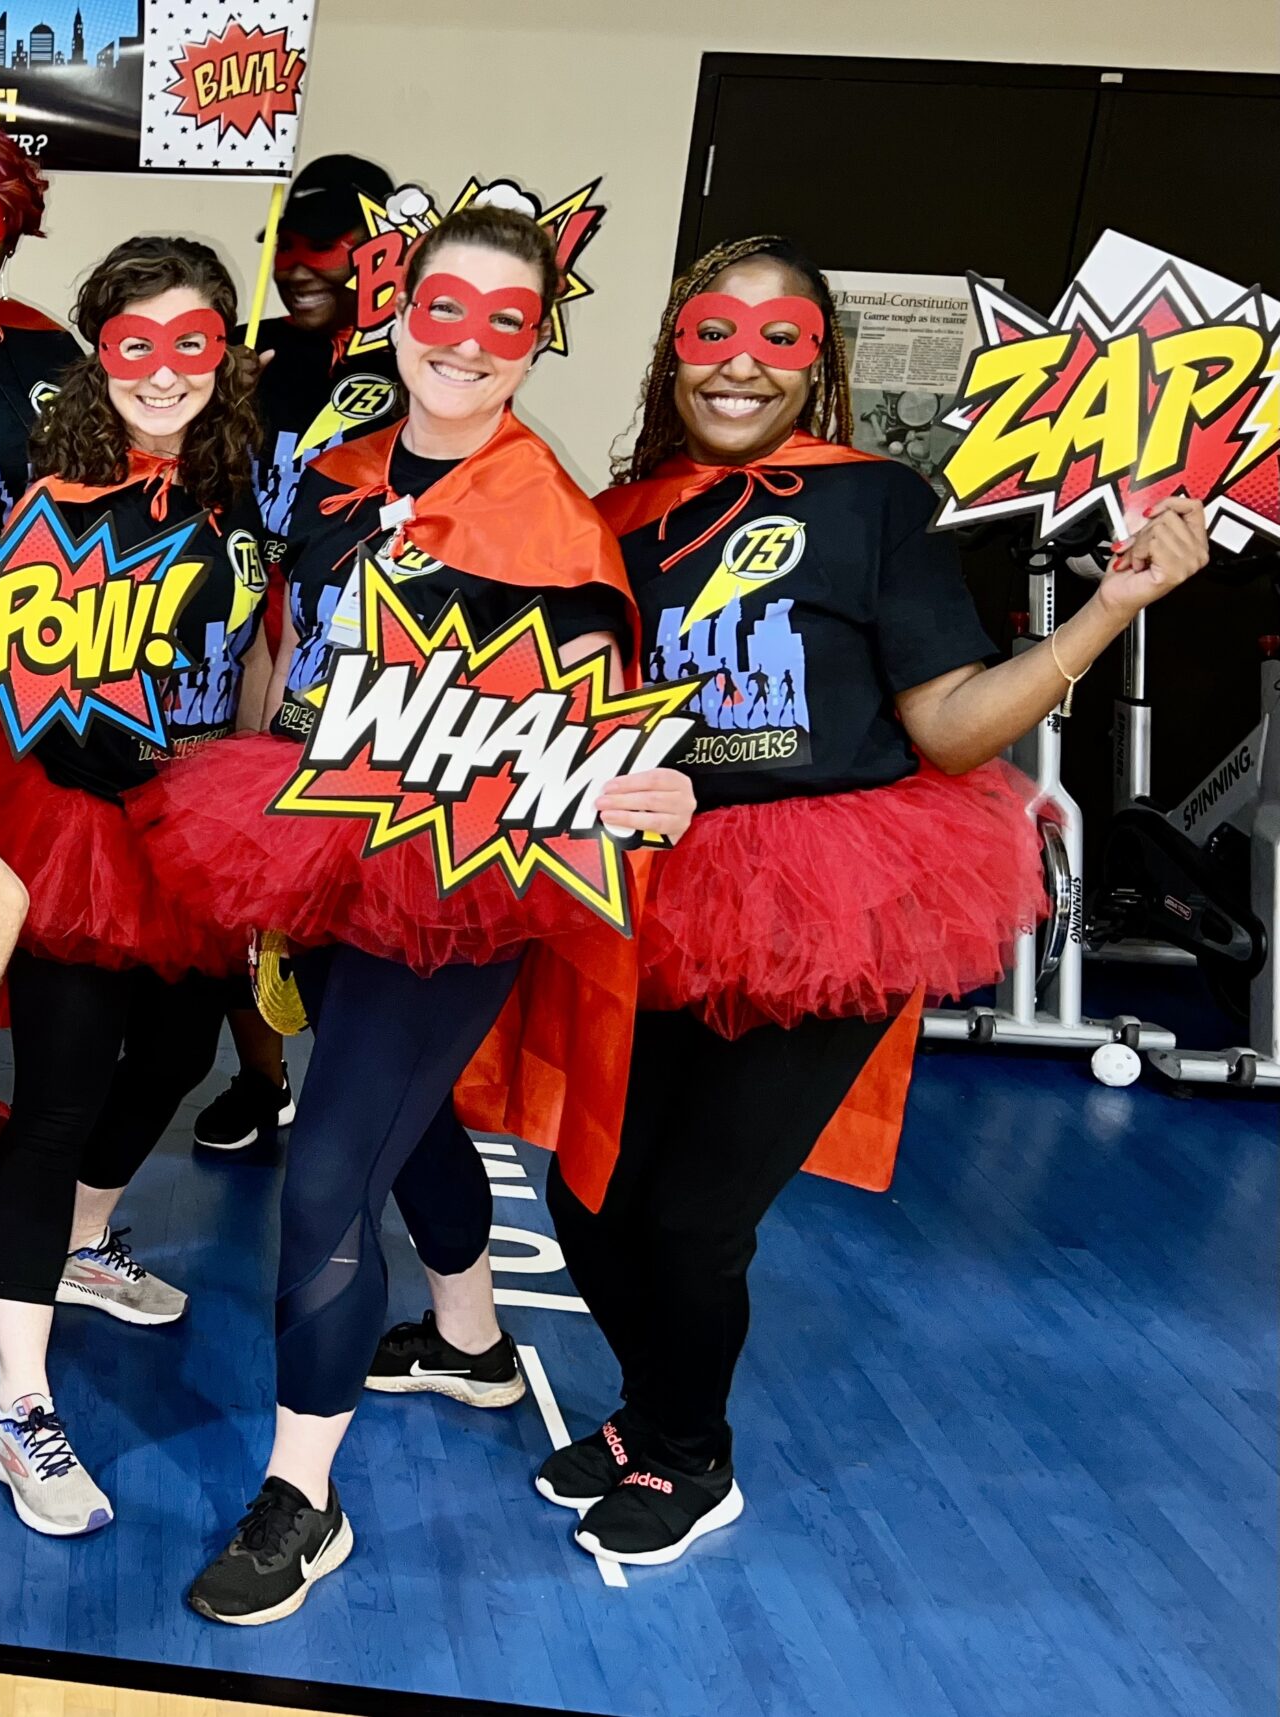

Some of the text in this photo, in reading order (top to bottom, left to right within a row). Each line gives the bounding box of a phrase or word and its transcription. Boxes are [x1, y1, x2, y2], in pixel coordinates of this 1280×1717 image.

[192, 49, 300, 110] BAM!
[841, 291, 969, 311] Journal-Constitution
[863, 311, 890, 321] Game
[891, 313, 917, 324] tough
[929, 314, 942, 324] its
[942, 316, 968, 325] name
[335, 382, 395, 415] TS
[943, 326, 1264, 500] ZAP
[728, 524, 802, 573] TS
